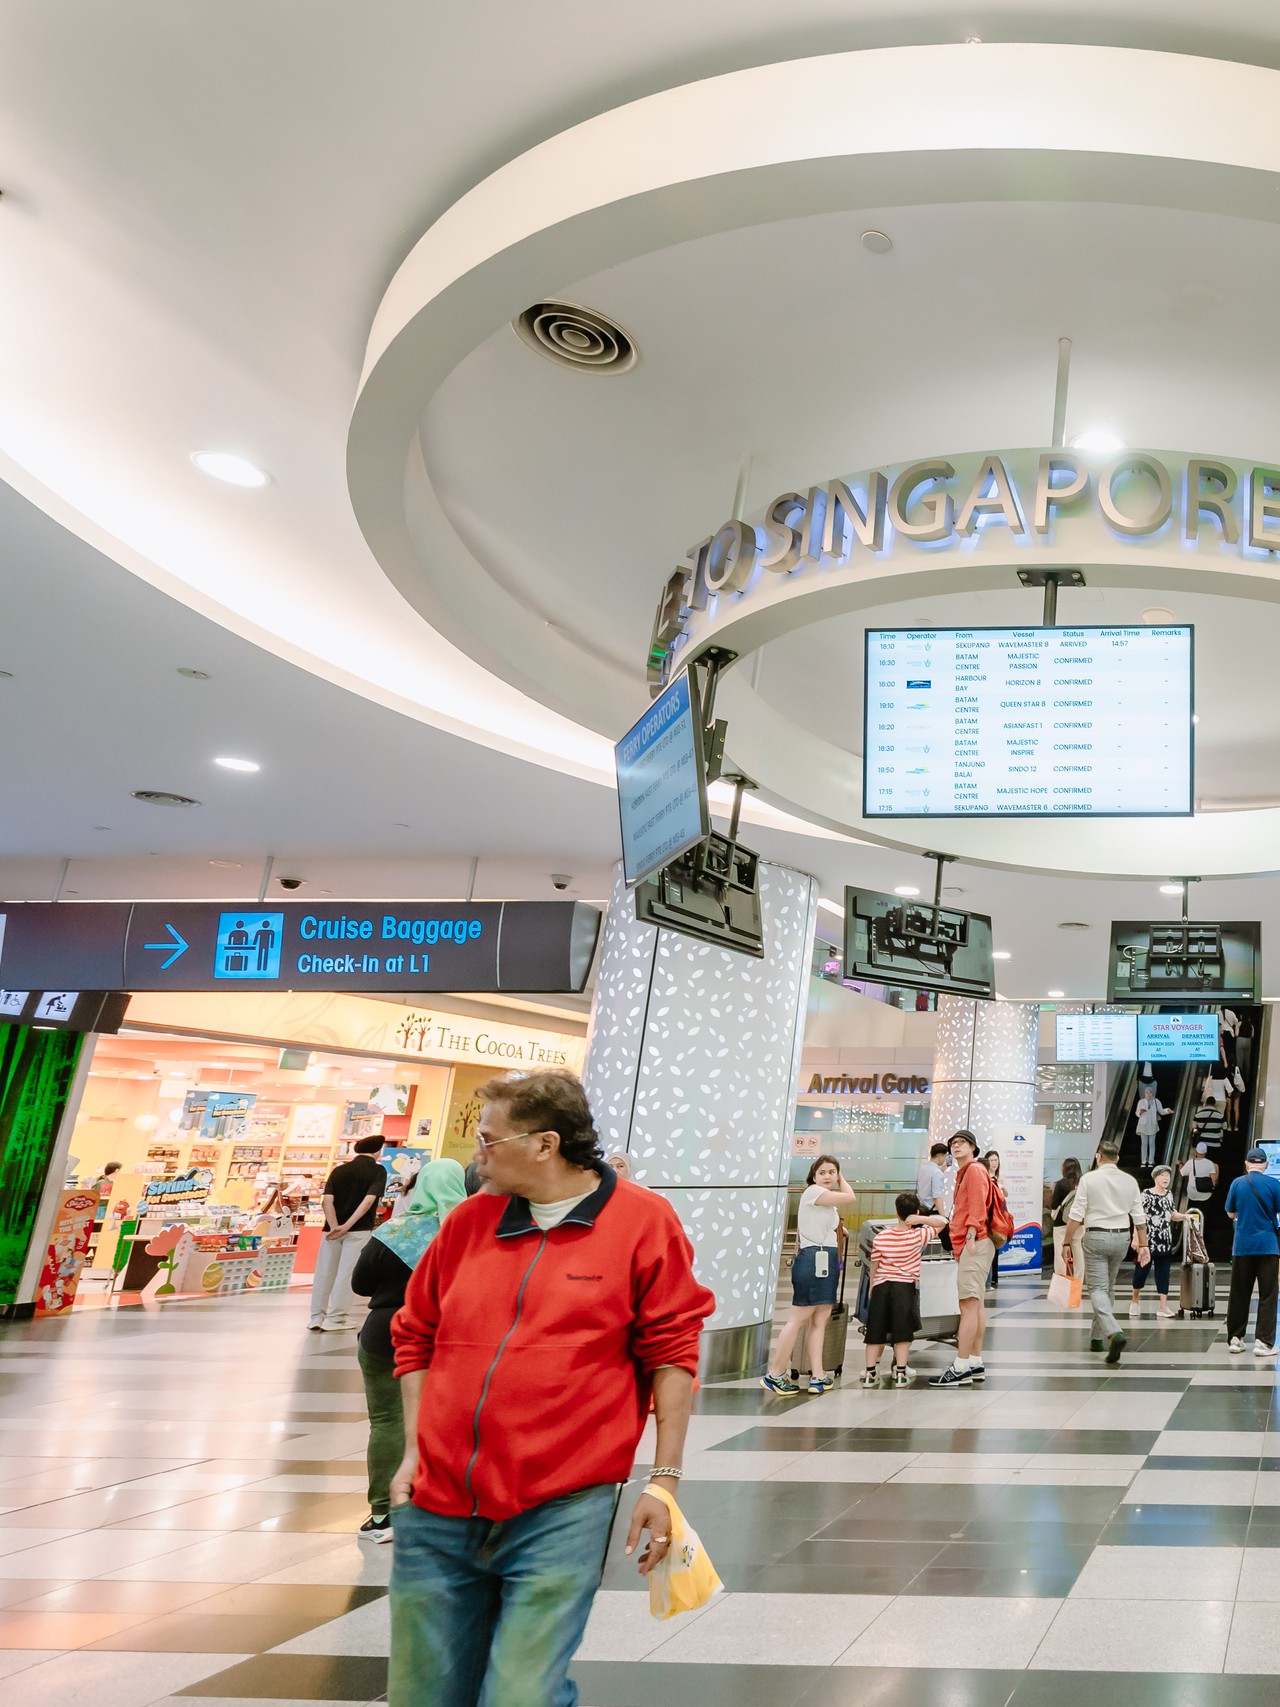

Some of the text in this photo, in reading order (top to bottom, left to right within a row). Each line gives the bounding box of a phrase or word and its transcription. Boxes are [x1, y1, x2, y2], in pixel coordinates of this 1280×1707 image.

[906, 632, 937, 640] Operator
[1100, 629, 1120, 637] Arrival
[1121, 629, 1141, 637] Time
[955, 641, 990, 649] SEKUPANG
[1007, 652, 1039, 660] MAJESTIC
[1054, 678, 1093, 686] CONFIRMED
[623, 731, 641, 763] FERRY
[641, 691, 680, 745] OPERATORS
[954, 782, 977, 790] BATAM
[300, 915, 482, 945] Cruise Baggage
[297, 954, 429, 973] Check-In at L1
[437, 1026, 567, 1065] THE COCOA TREES
[807, 1072, 929, 1094] Arrival Gate
